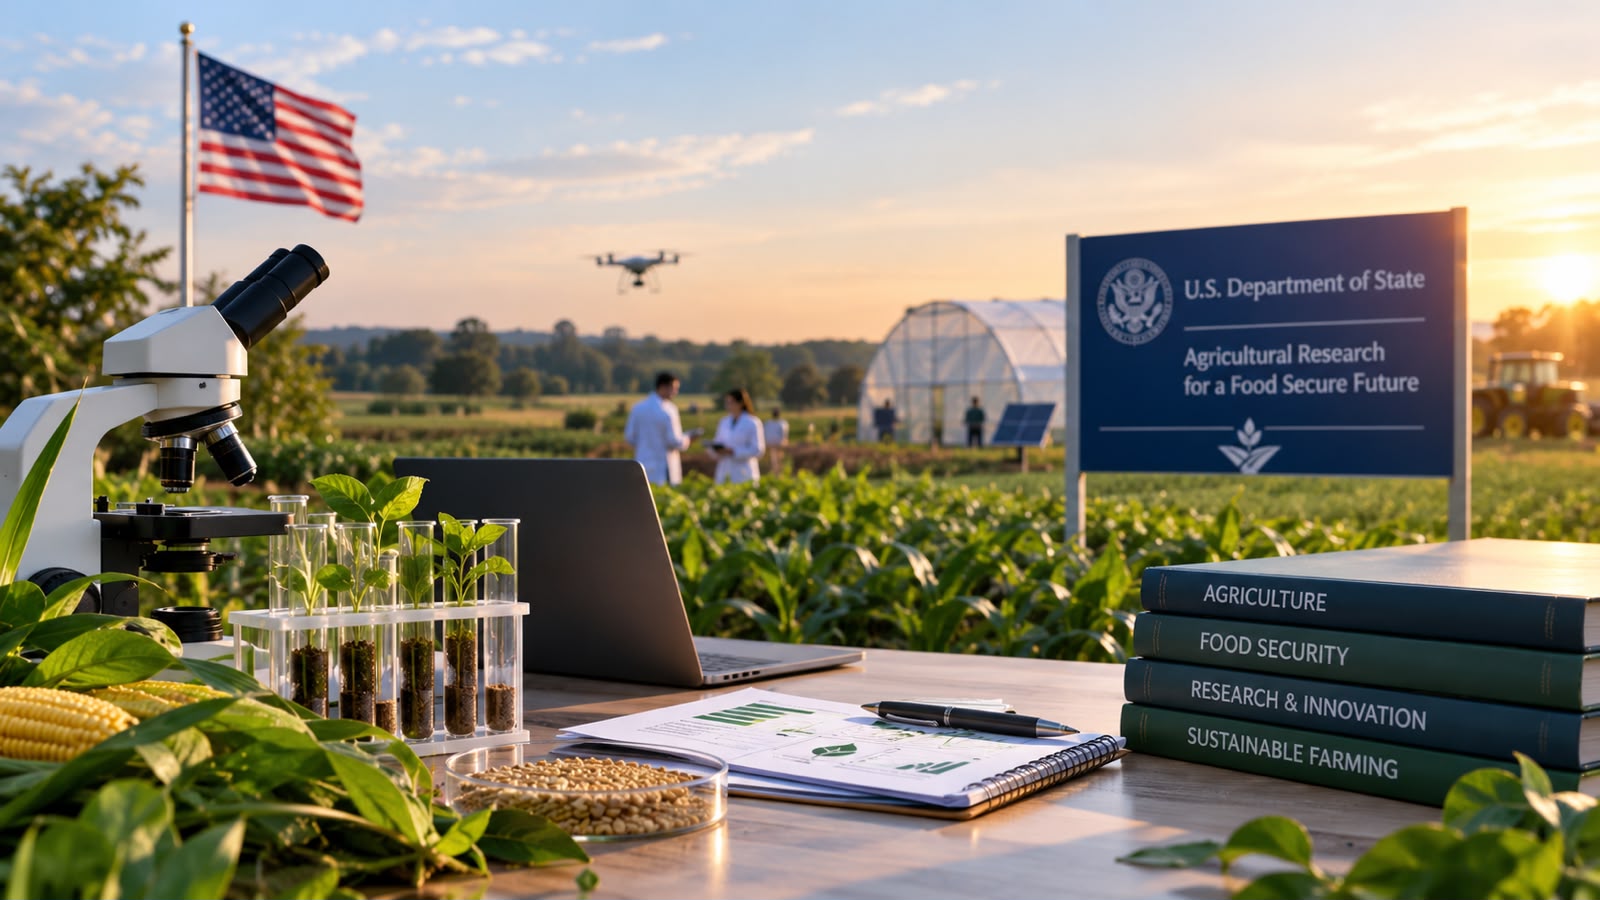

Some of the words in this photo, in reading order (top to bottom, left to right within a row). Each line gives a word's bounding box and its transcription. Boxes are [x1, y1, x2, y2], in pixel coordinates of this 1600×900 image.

[1184, 278, 1222, 300] U.S.
[1227, 273, 1345, 302] Department
[1348, 269, 1372, 292] of
[1374, 269, 1426, 291] State
[1183, 343, 1294, 372] Agricultural
[1298, 340, 1386, 364] Research
[1183, 375, 1211, 396] for
[1214, 380, 1226, 396] a
[1230, 373, 1278, 395] Food
[1282, 373, 1349, 395] Secure
[1353, 372, 1420, 393] Future
[1203, 583, 1328, 613] AGRICULTURE
[1200, 631, 1252, 655] FOOD
[1256, 637, 1350, 666] SECURITY
[1191, 679, 1279, 710] RESEARCH
[1284, 692, 1298, 713] &
[1303, 694, 1427, 731] INNOVATION
[1187, 726, 1304, 764] SUSTAINABLE
[1309, 745, 1398, 780] FARMING
